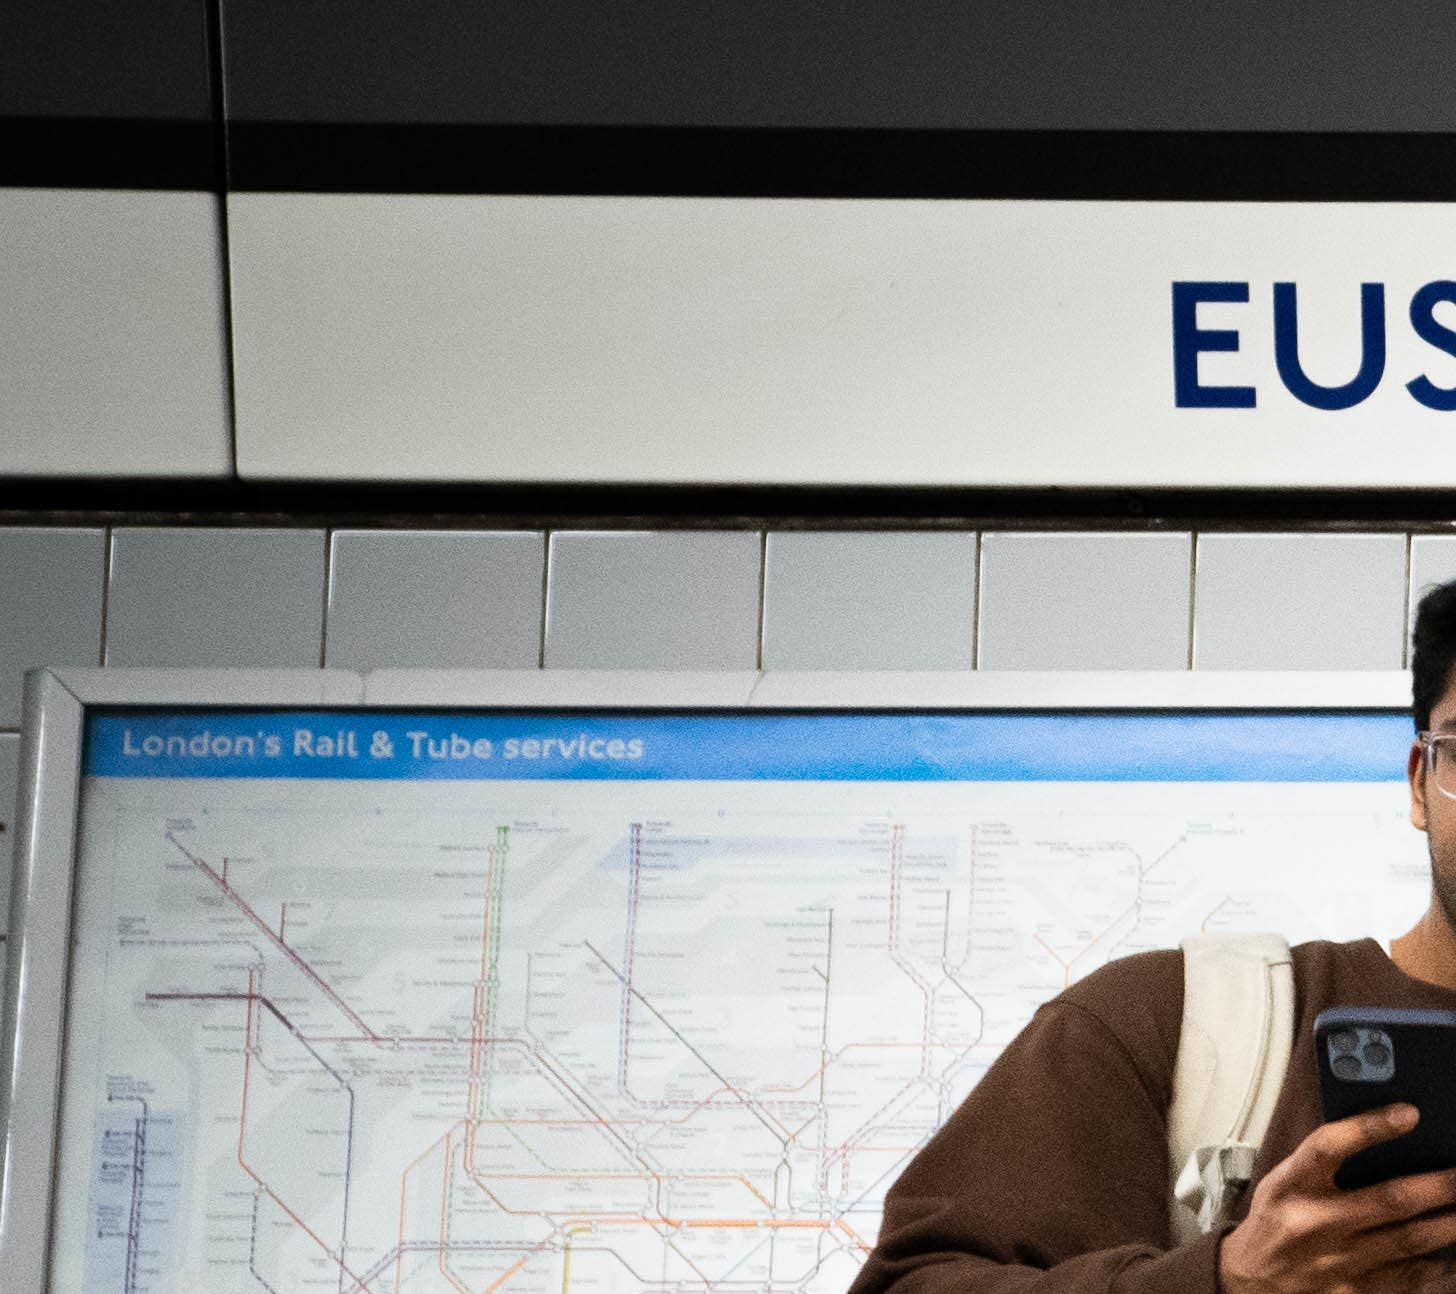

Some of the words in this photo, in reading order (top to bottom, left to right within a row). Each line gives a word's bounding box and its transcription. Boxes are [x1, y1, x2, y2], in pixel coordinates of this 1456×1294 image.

[122, 729, 281, 758] London's
[293, 729, 359, 758] Rail
[370, 731, 394, 759] &
[406, 731, 494, 760] Tube
[502, 732, 644, 761] services
